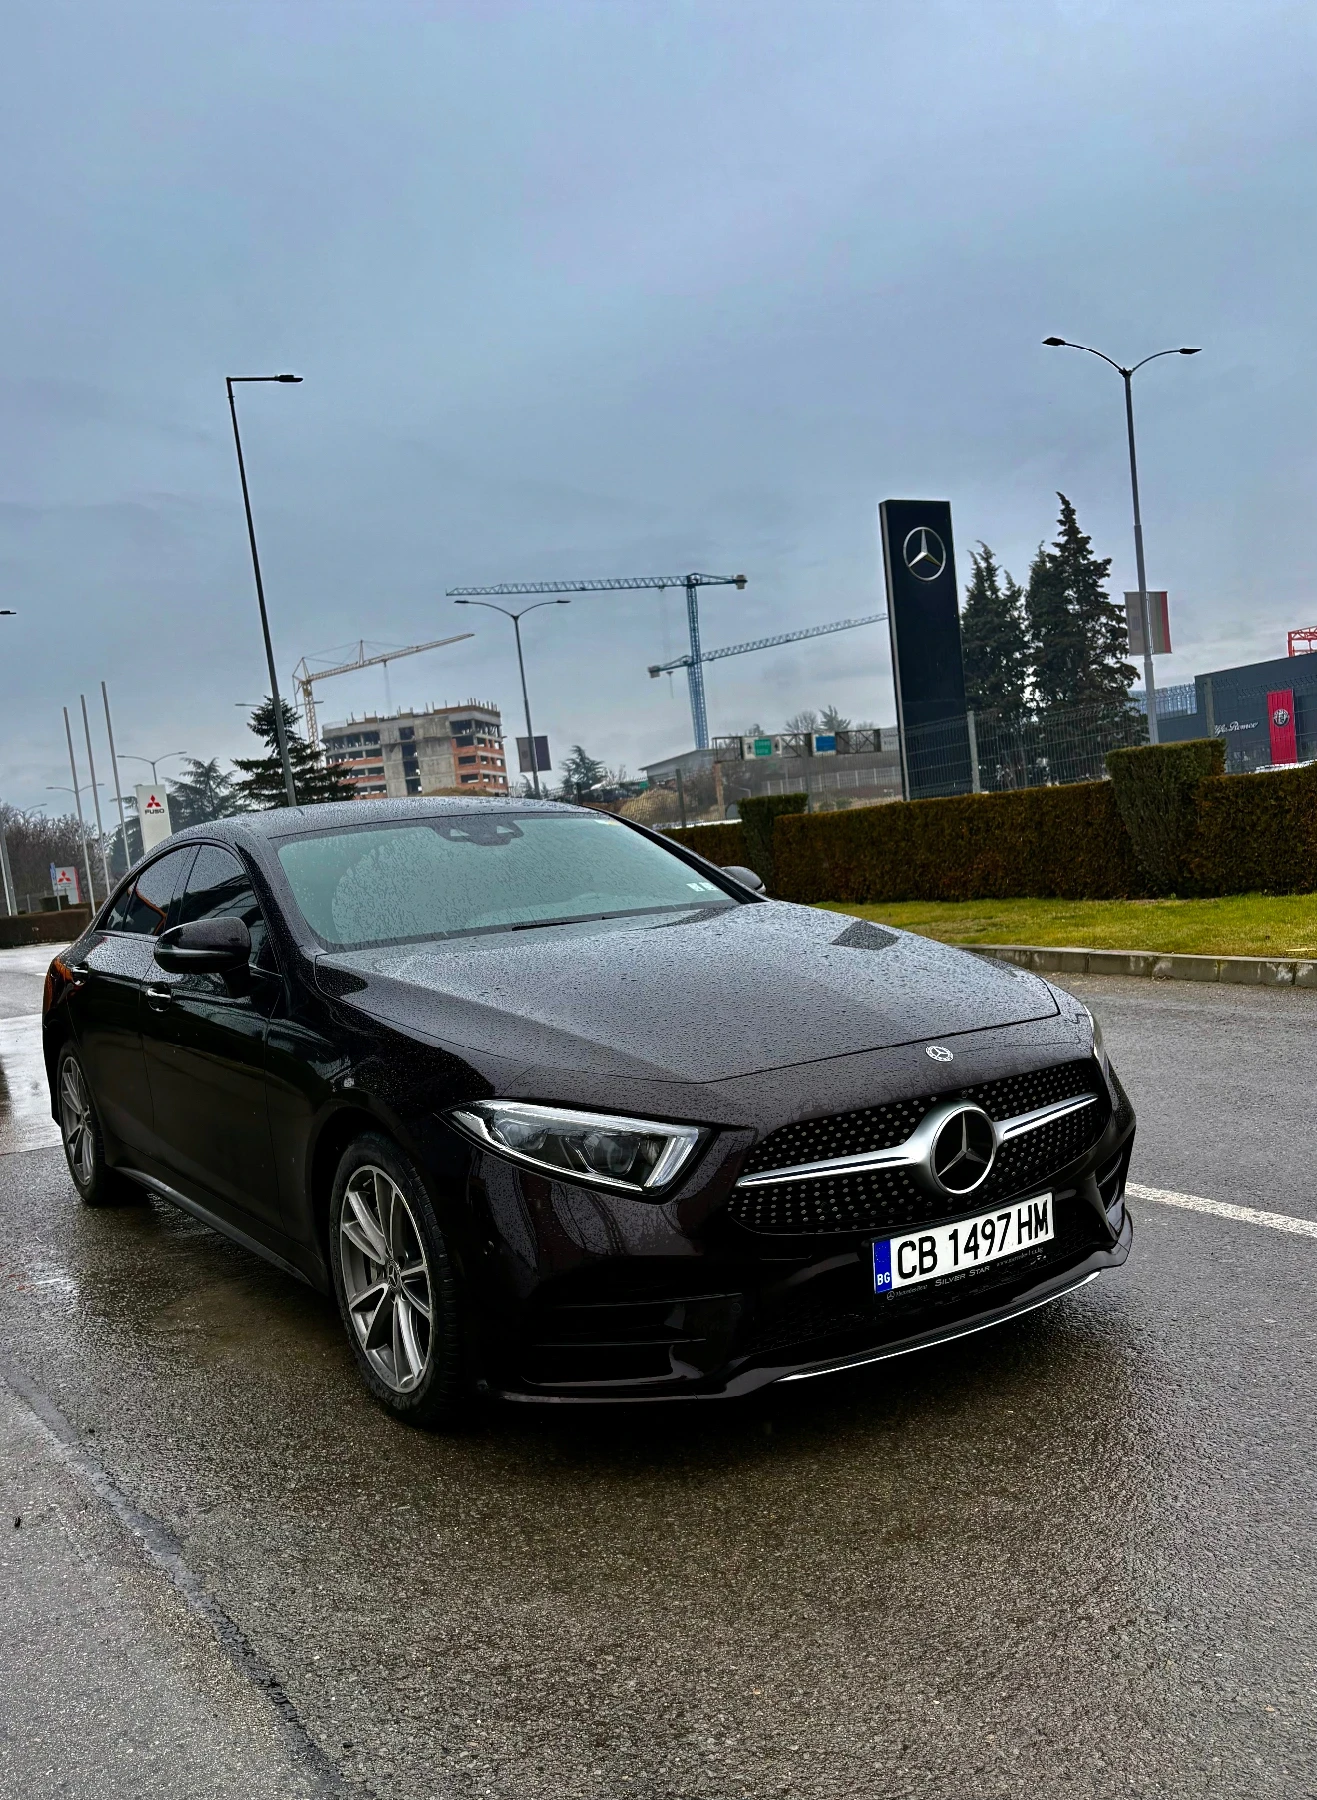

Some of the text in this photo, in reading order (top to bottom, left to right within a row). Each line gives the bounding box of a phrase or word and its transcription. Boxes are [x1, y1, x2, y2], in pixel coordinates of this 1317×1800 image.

[1228, 721, 1259, 732] Romeo
[897, 1235, 938, 1280] CB
[948, 1212, 1012, 1266] 1497
[1017, 1200, 1049, 1245] HM
[876, 1271, 891, 1286] BG
